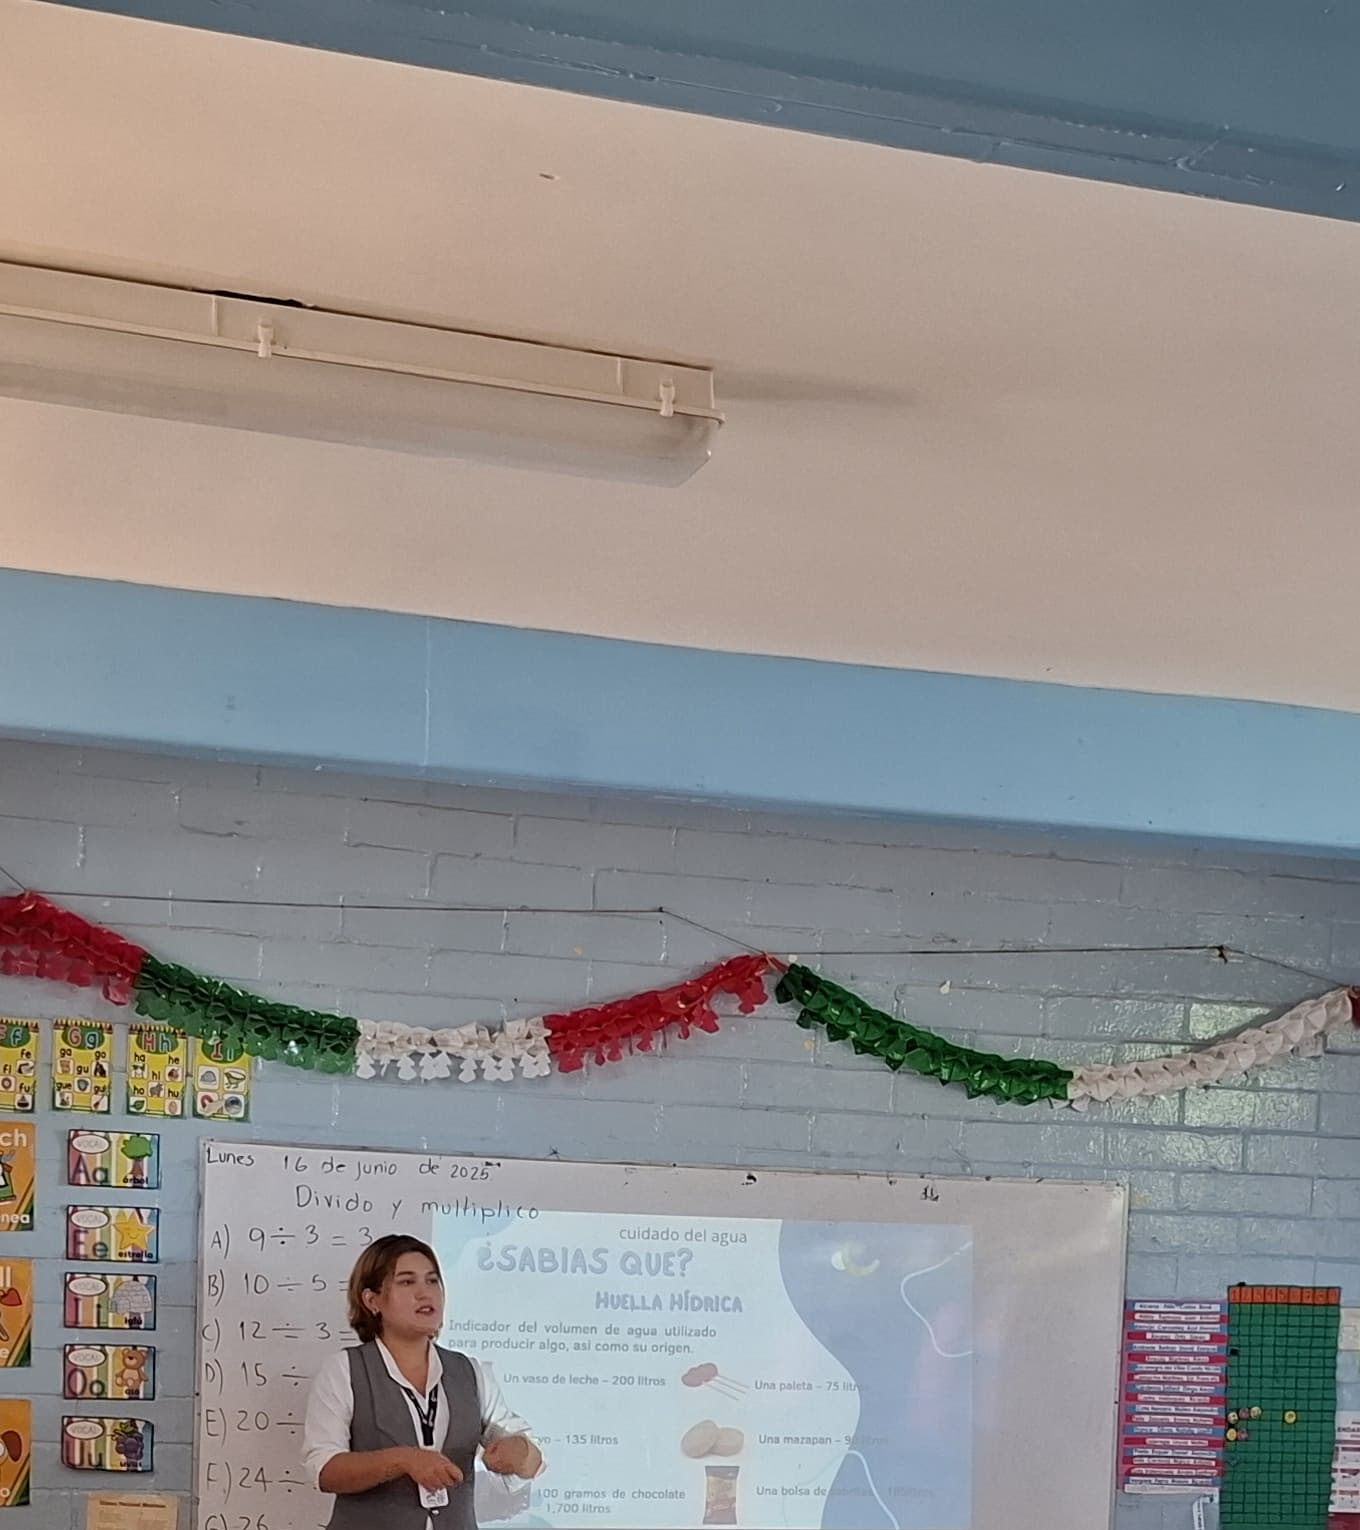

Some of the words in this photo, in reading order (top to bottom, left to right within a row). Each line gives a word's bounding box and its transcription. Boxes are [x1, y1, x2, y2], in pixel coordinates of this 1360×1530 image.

[206, 1147, 255, 1168] Lunes
[283, 1156, 308, 1173] 16
[321, 1153, 346, 1174] de
[355, 1158, 398, 1181] junio
[418, 1154, 439, 1175] de
[450, 1162, 490, 1181] 2025
[295, 1184, 374, 1212] Divido
[392, 1199, 402, 1219] y
[421, 1196, 539, 1224] multiplico
[619, 1227, 680, 1242] cuidado
[684, 1228, 706, 1242] del
[711, 1230, 747, 1247] agua
[477, 1242, 609, 1275] ¿SABIAS
[619, 1247, 693, 1277] QUE?
[595, 1291, 662, 1312] HUELLA
[669, 1289, 743, 1313] HÍDRICA
[448, 1319, 510, 1333] Indicador
[518, 1320, 537, 1333] del
[544, 1322, 597, 1335] volumen
[604, 1323, 620, 1336] de
[627, 1326, 657, 1339] agua
[664, 1324, 717, 1338] utilizado
[448, 1338, 477, 1351] para
[481, 1337, 535, 1352] producir
[539, 1338, 569, 1354] algo,
[595, 1342, 629, 1352] como
[633, 1342, 648, 1353] su
[651, 1341, 691, 1356] origen.
[503, 1374, 519, 1384] Un
[522, 1375, 549, 1384] vaso
[552, 1374, 566, 1385] de
[569, 1374, 599, 1385] leche
[612, 1376, 635, 1386] 200
[638, 1375, 666, 1386] litros
[754, 1380, 776, 1390] Una
[779, 1381, 813, 1393] paleta
[826, 1381, 840, 1391] 75
[566, 1435, 587, 1445] 135
[590, 1434, 619, 1445] litros
[759, 1434, 780, 1445] Una
[536, 1489, 558, 1499] 100
[564, 1489, 607, 1500] gramos
[612, 1489, 626, 1499] de
[631, 1489, 686, 1500] chocolate
[756, 1486, 778, 1496] Una
[781, 1485, 810, 1496] bolsa
[813, 1485, 827, 1496] de
[546, 1503, 579, 1514] 1,700
[582, 1503, 612, 1514] litros
